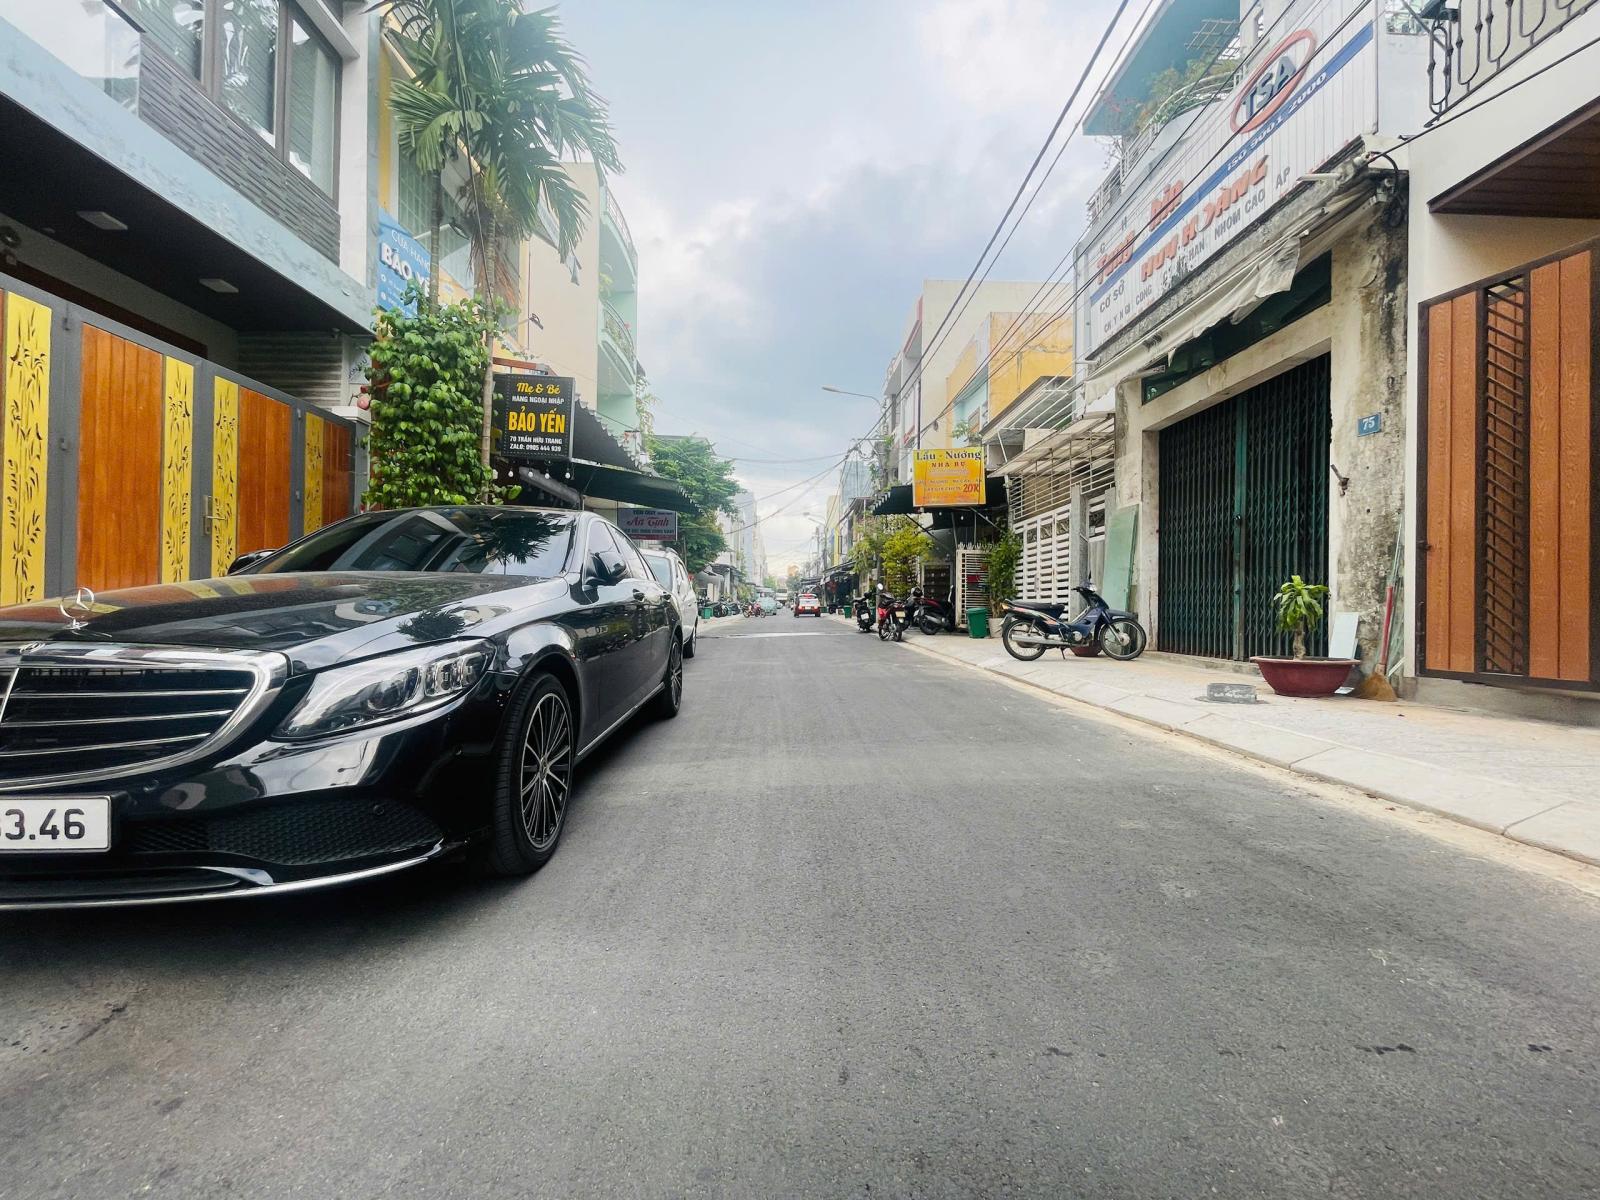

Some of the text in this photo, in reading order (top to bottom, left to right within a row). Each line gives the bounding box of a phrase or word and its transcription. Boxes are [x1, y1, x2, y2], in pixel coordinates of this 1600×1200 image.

[1242, 55, 1296, 120] TSA
[1288, 72, 1327, 113] 2000
[1245, 188, 1265, 214] CAO
[516, 382, 560, 394] Mẹ & Bé
[508, 405, 566, 433] BẢO YẾN
[1363, 416, 1375, 430] 75
[945, 450, 982, 461] Nướng
[0, 808, 86, 840] 3.46
